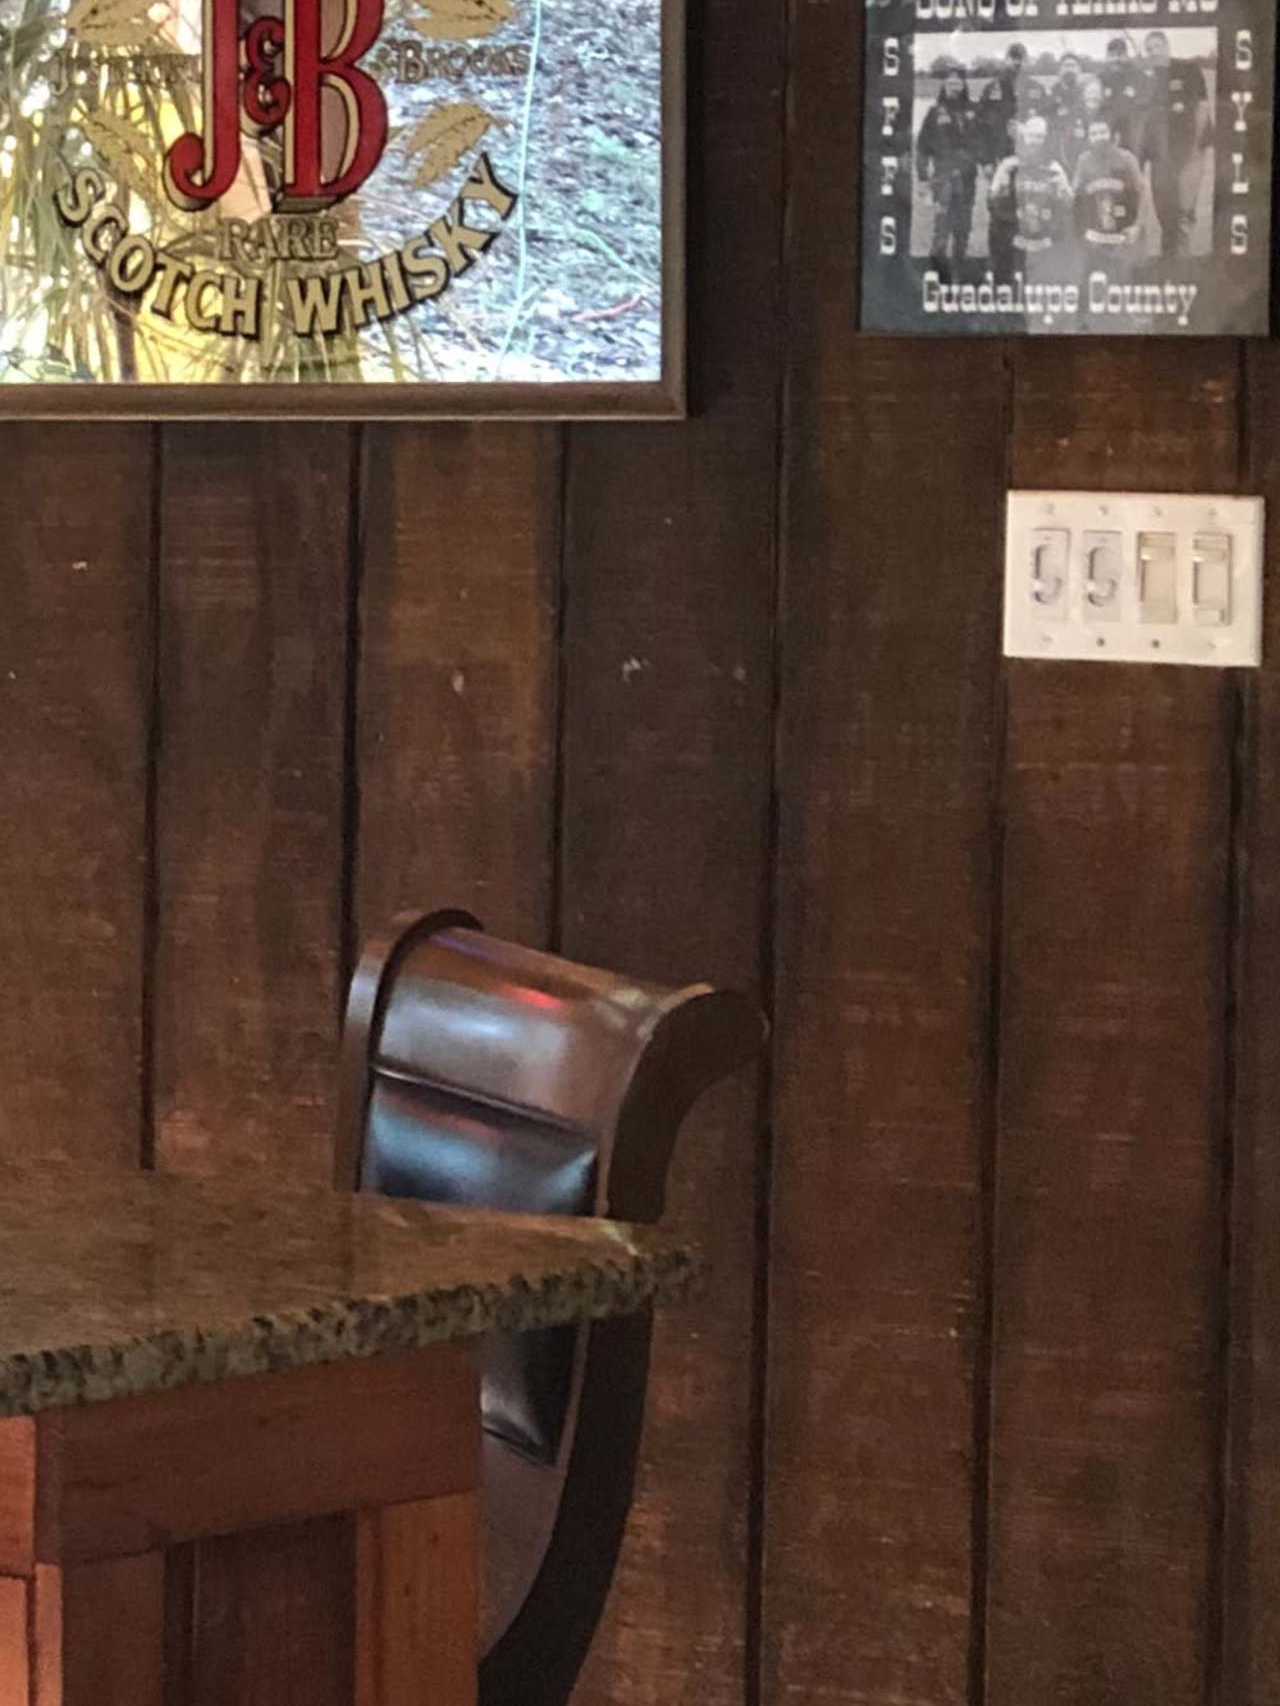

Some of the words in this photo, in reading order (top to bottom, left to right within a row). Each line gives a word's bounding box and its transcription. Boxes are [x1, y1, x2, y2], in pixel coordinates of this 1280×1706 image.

[54, 163, 261, 338] SCOTCH
[288, 153, 518, 336] WHISKY
[220, 216, 340, 261] RARE
[923, 270, 1079, 325] Guadalupe
[1089, 270, 1197, 326] County
